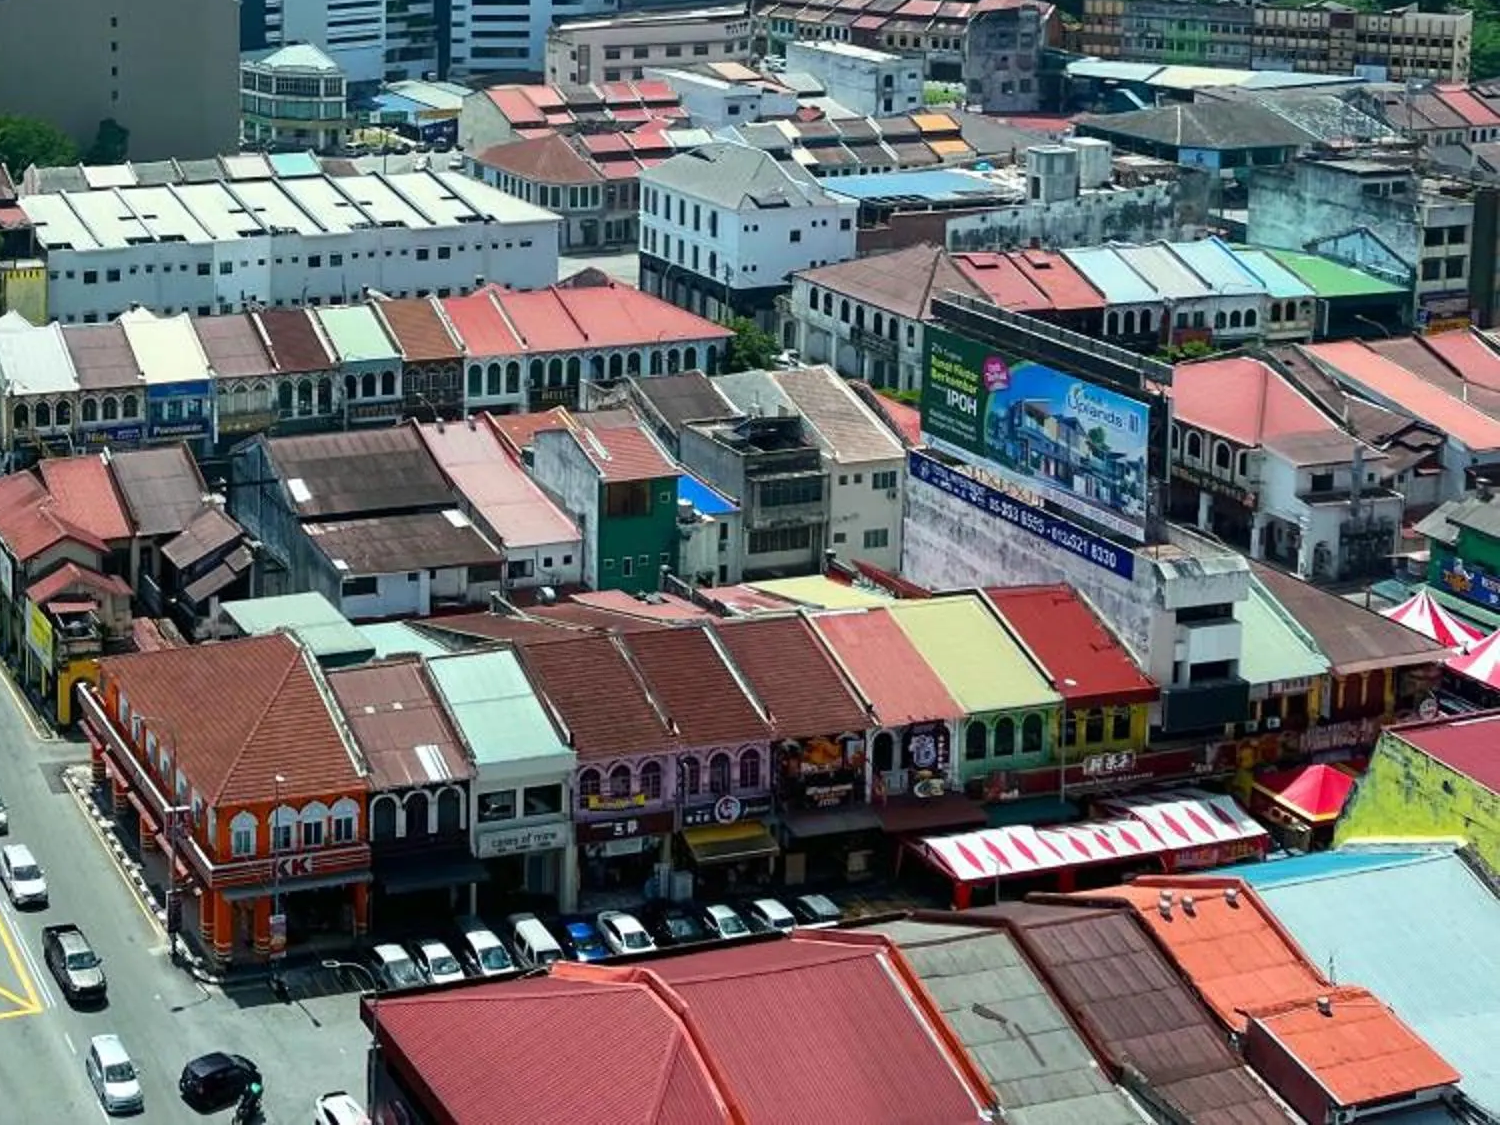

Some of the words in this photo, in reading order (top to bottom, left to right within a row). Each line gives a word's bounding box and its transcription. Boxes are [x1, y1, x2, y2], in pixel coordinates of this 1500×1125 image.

[947, 389, 977, 417] IPOH
[1067, 392, 1124, 428] Uplands
[272, 857, 309, 877] KK
